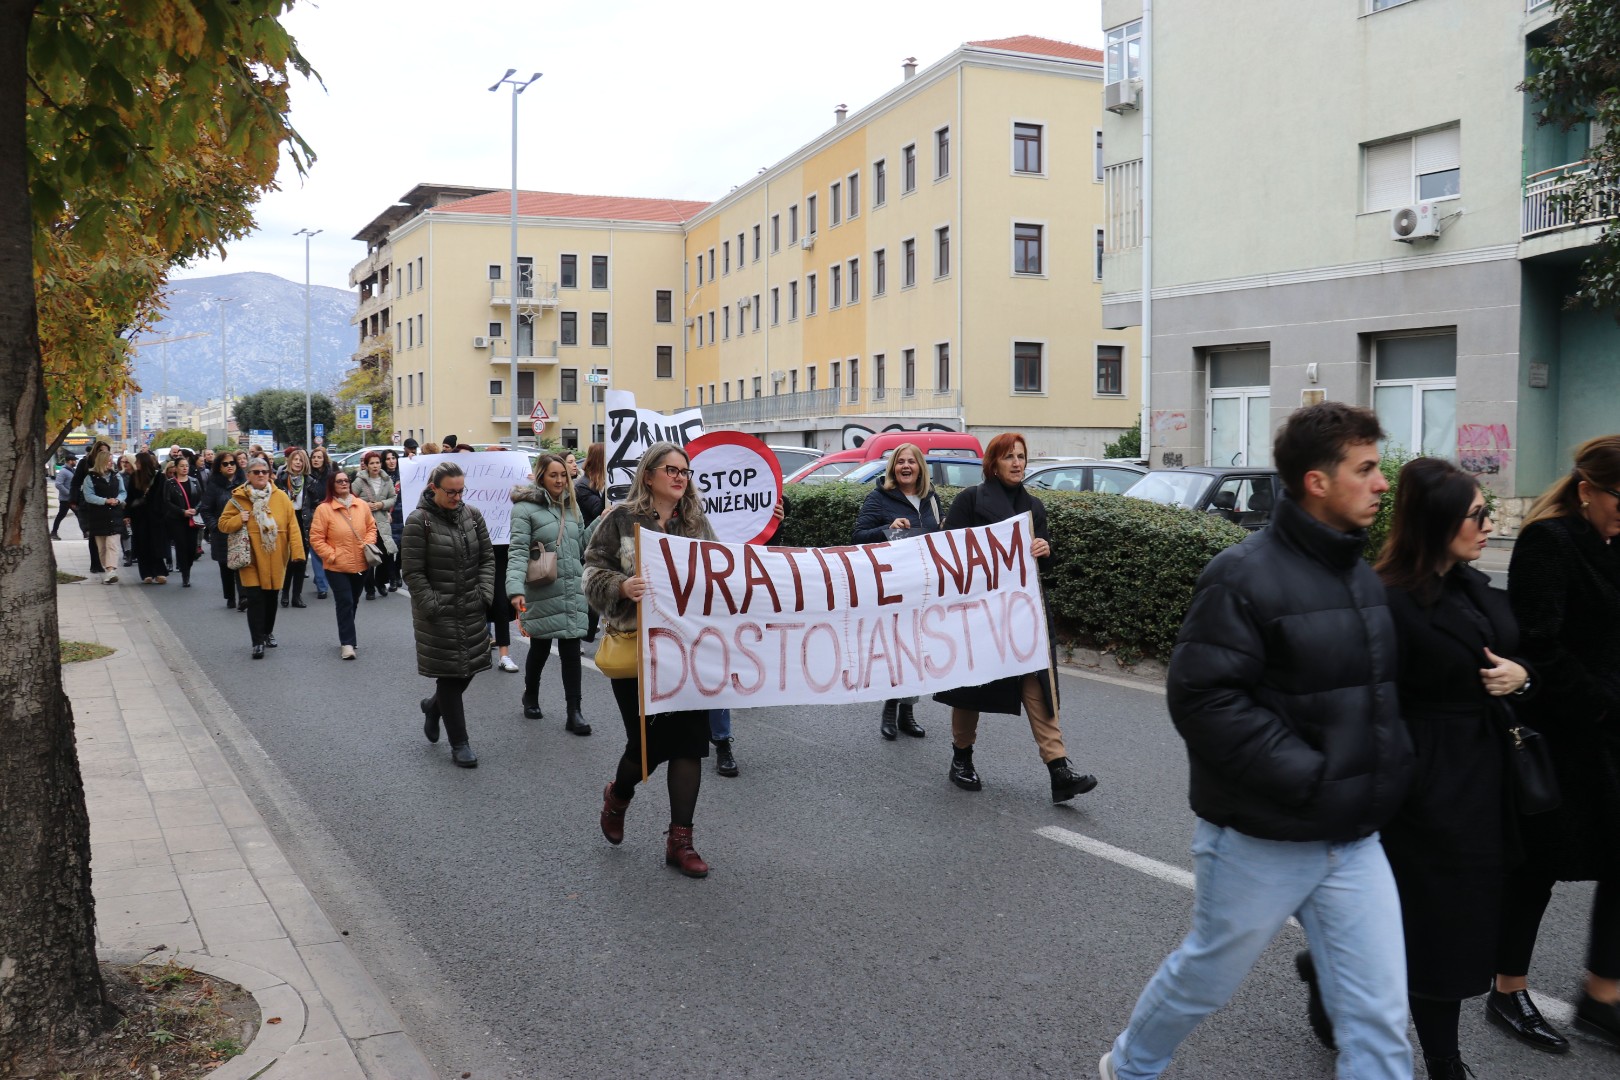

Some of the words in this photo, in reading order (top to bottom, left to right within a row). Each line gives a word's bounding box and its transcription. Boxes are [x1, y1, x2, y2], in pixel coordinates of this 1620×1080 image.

[583, 374, 599, 383] LED
[360, 410, 368, 418] P
[535, 422, 543, 431] 50
[698, 468, 757, 493] STOP
[702, 490, 772, 514] ONIŽENJU
[659, 538, 903, 616] VRATITE
[924, 521, 1026, 597] NAM
[648, 590, 1039, 702] DOSTOJANSTVO
